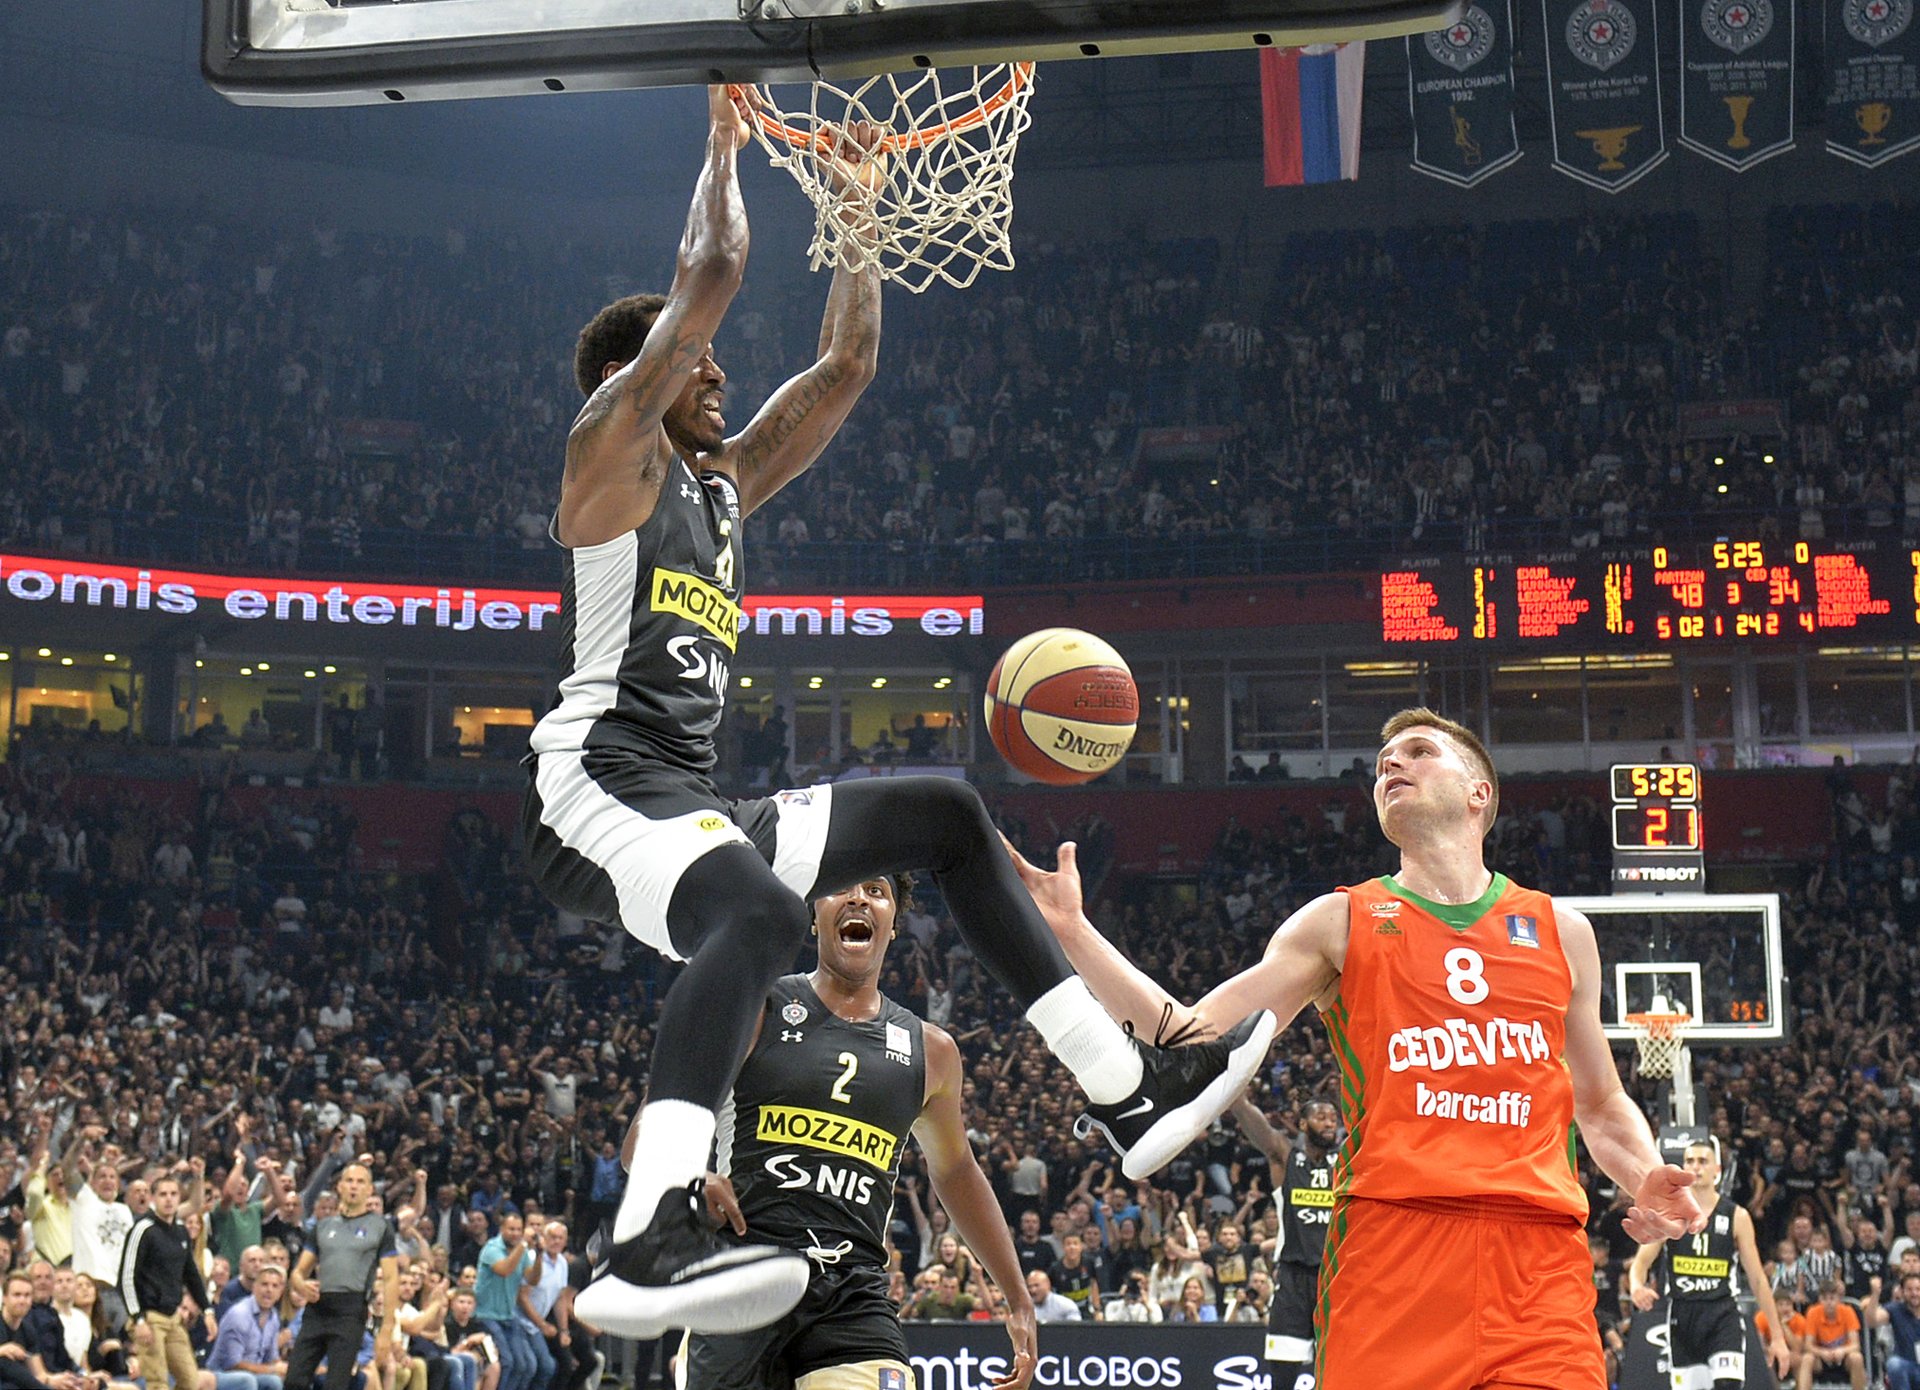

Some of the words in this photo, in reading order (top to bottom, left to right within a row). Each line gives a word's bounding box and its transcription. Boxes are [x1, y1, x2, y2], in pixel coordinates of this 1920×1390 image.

[1417, 79, 1463, 94] EUROPEAN
[1464, 74, 1507, 89] CHAMPION
[1654, 548, 1667, 569] 0
[1795, 542, 1809, 563] 0
[1654, 570, 1705, 585] PARTIZAN
[0, 568, 198, 614] omis
[225, 586, 558, 631] enterijer
[1672, 583, 1703, 608] 48
[1727, 582, 1740, 604] 3
[1769, 579, 1799, 605] 34
[658, 578, 739, 642] MOZZA
[1383, 627, 1459, 642] PAPAPETROU
[1657, 617, 1671, 639] 5
[1631, 767, 1694, 796] 5:25
[1640, 867, 1699, 881] TISSOT
[1443, 947, 1490, 1005] 8
[1388, 1017, 1550, 1073] CEDEVITA
[885, 1050, 911, 1067] mts
[830, 1051, 858, 1104] 2
[762, 1111, 893, 1162] MOZZART
[1310, 1168, 1329, 1188] 26
[1294, 1192, 1335, 1204] MOZZA
[1691, 1232, 1709, 1257] 41
[1676, 1260, 1726, 1273] MOZZART
[908, 1347, 1009, 1390] mts
[1034, 1356, 1183, 1388] GLOBOS
